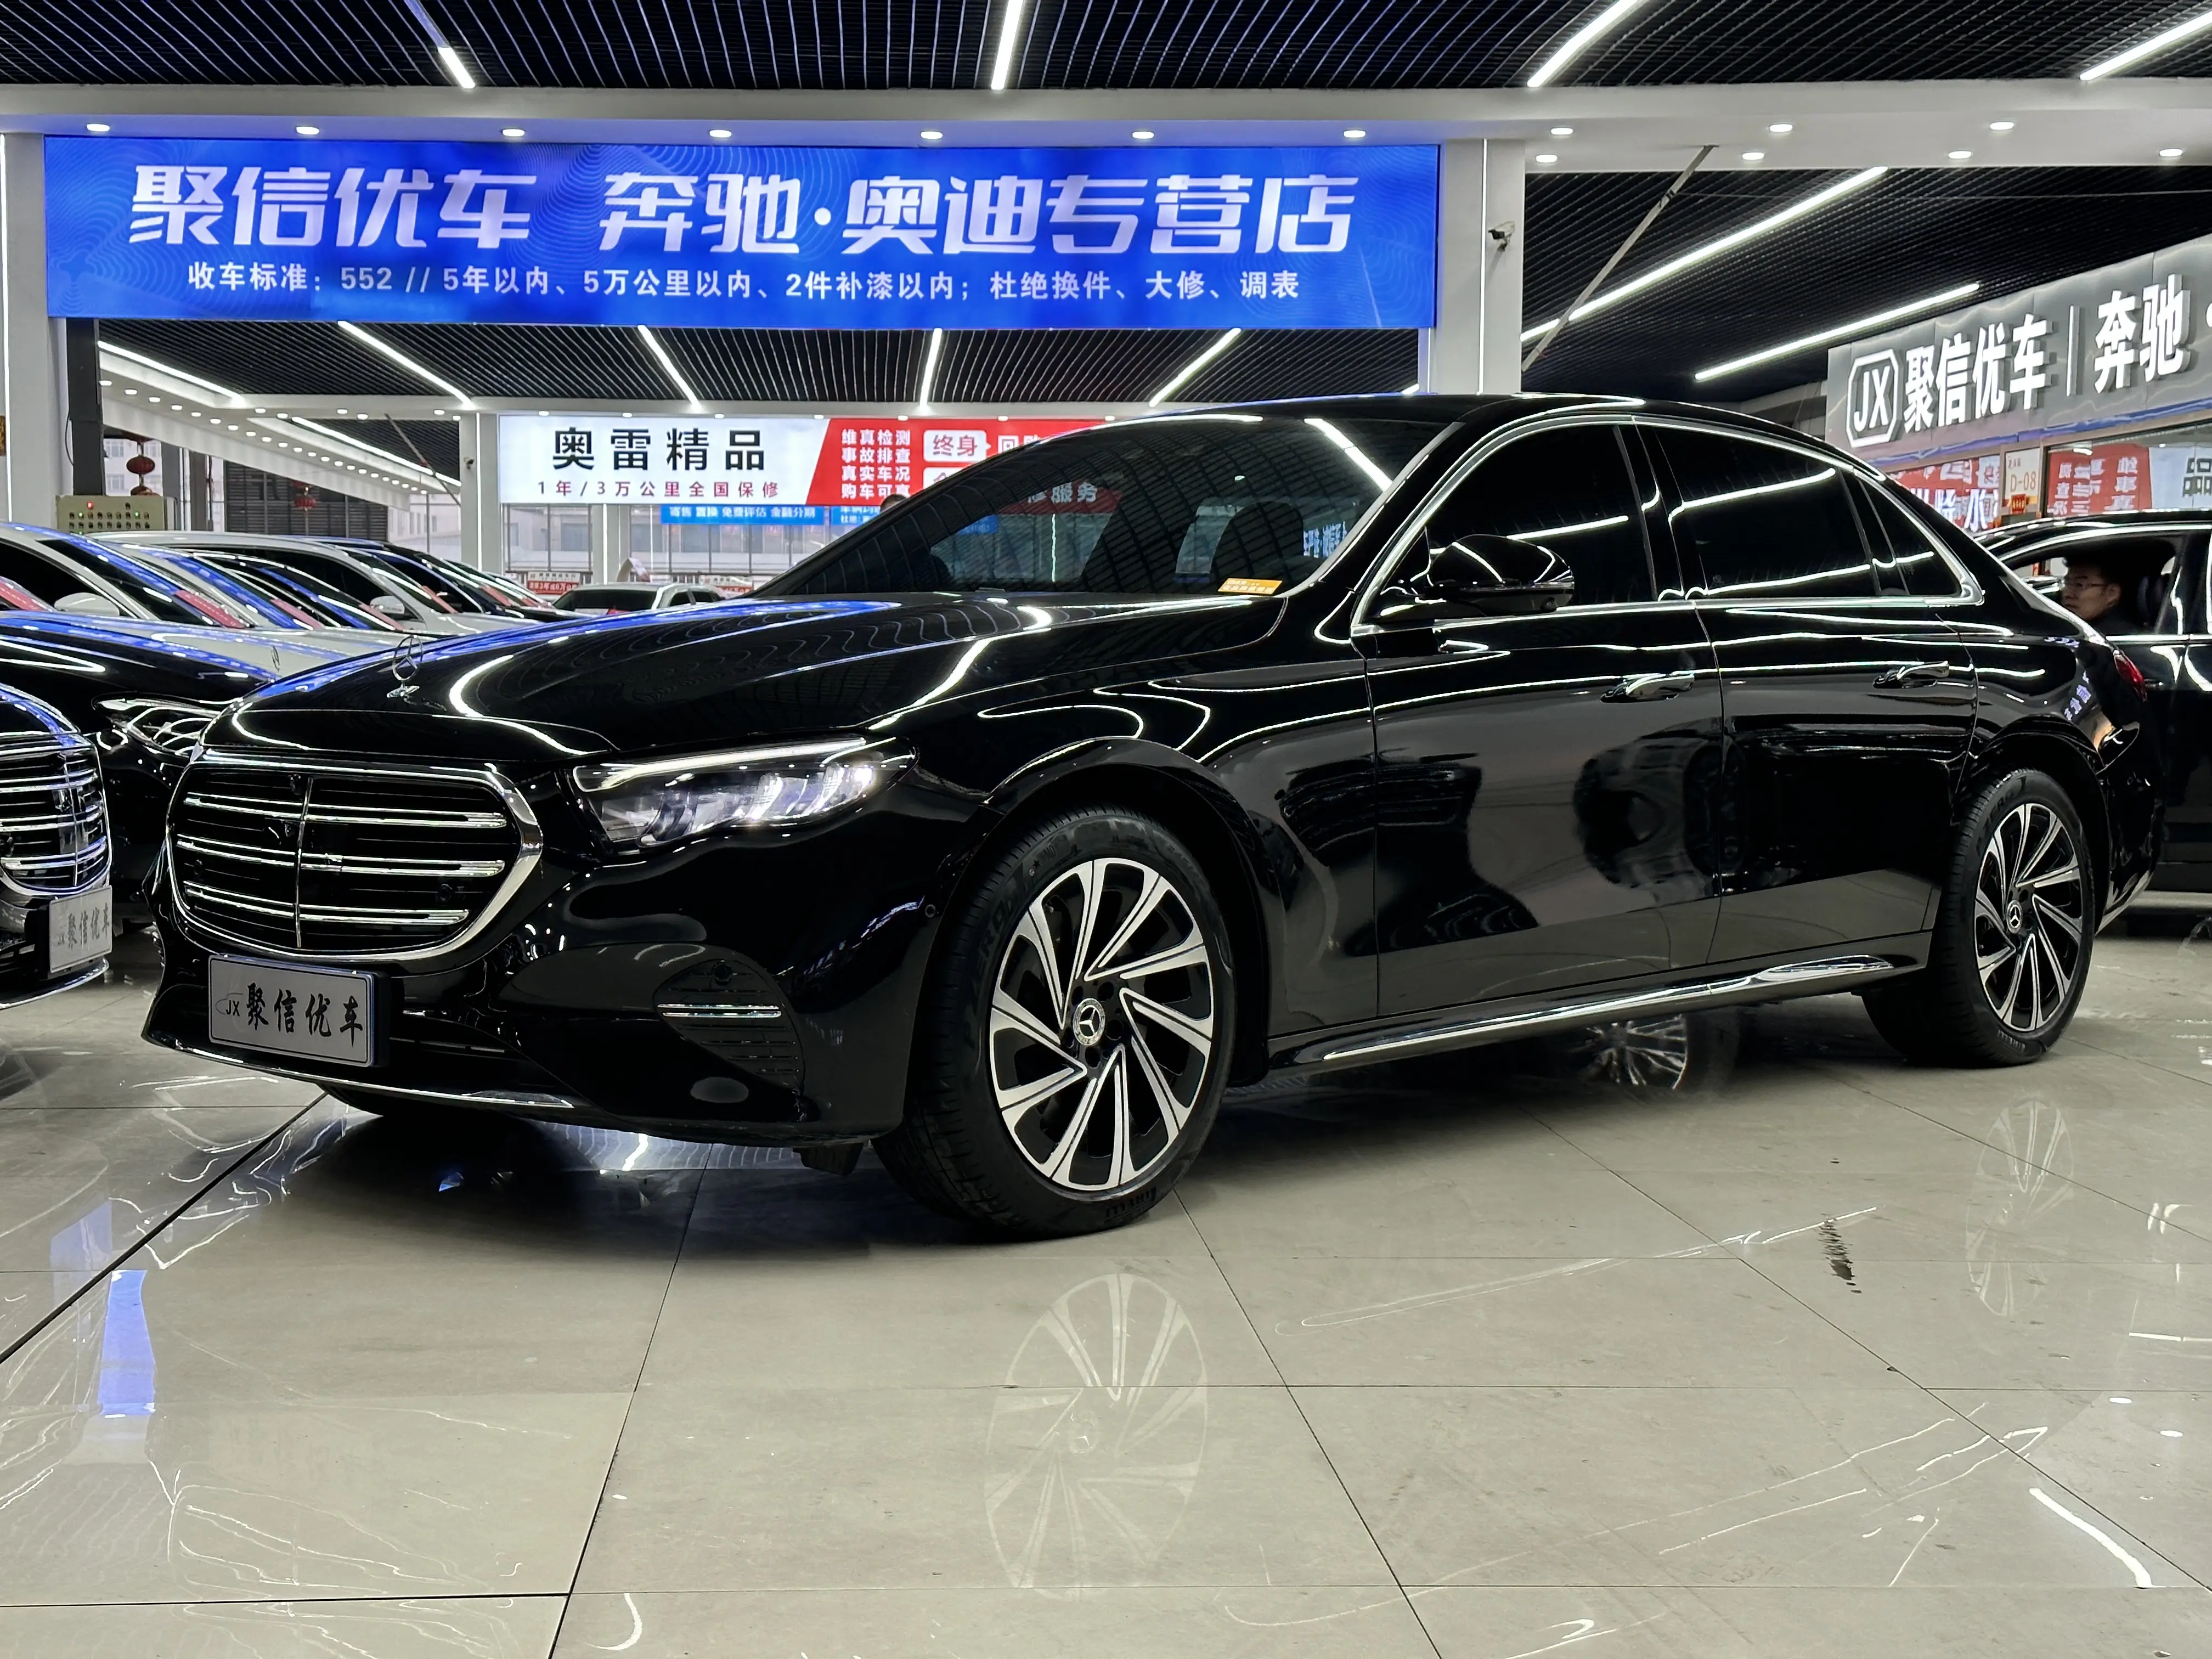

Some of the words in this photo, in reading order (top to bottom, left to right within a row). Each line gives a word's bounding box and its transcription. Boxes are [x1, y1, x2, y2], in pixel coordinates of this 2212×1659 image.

[129, 165, 537, 249] 聚信优车
[1903, 313, 2048, 433] 聚信优车
[1853, 366, 1891, 432] JX
[842, 429, 911, 446] 维真检测
[933, 435, 978, 456] 终身
[552, 427, 764, 471] 奥雷精品
[842, 447, 911, 464] 事故排查
[842, 465, 911, 482] 真实车况
[2011, 471, 2036, 492] D-08
[538, 480, 779, 498] 1年/3万公里全国保修
[722, 506, 767, 517] 免费评估
[770, 506, 816, 517] 金融分期
[225, 999, 241, 1017] JX
[246, 982, 363, 1047] 聚信优车
